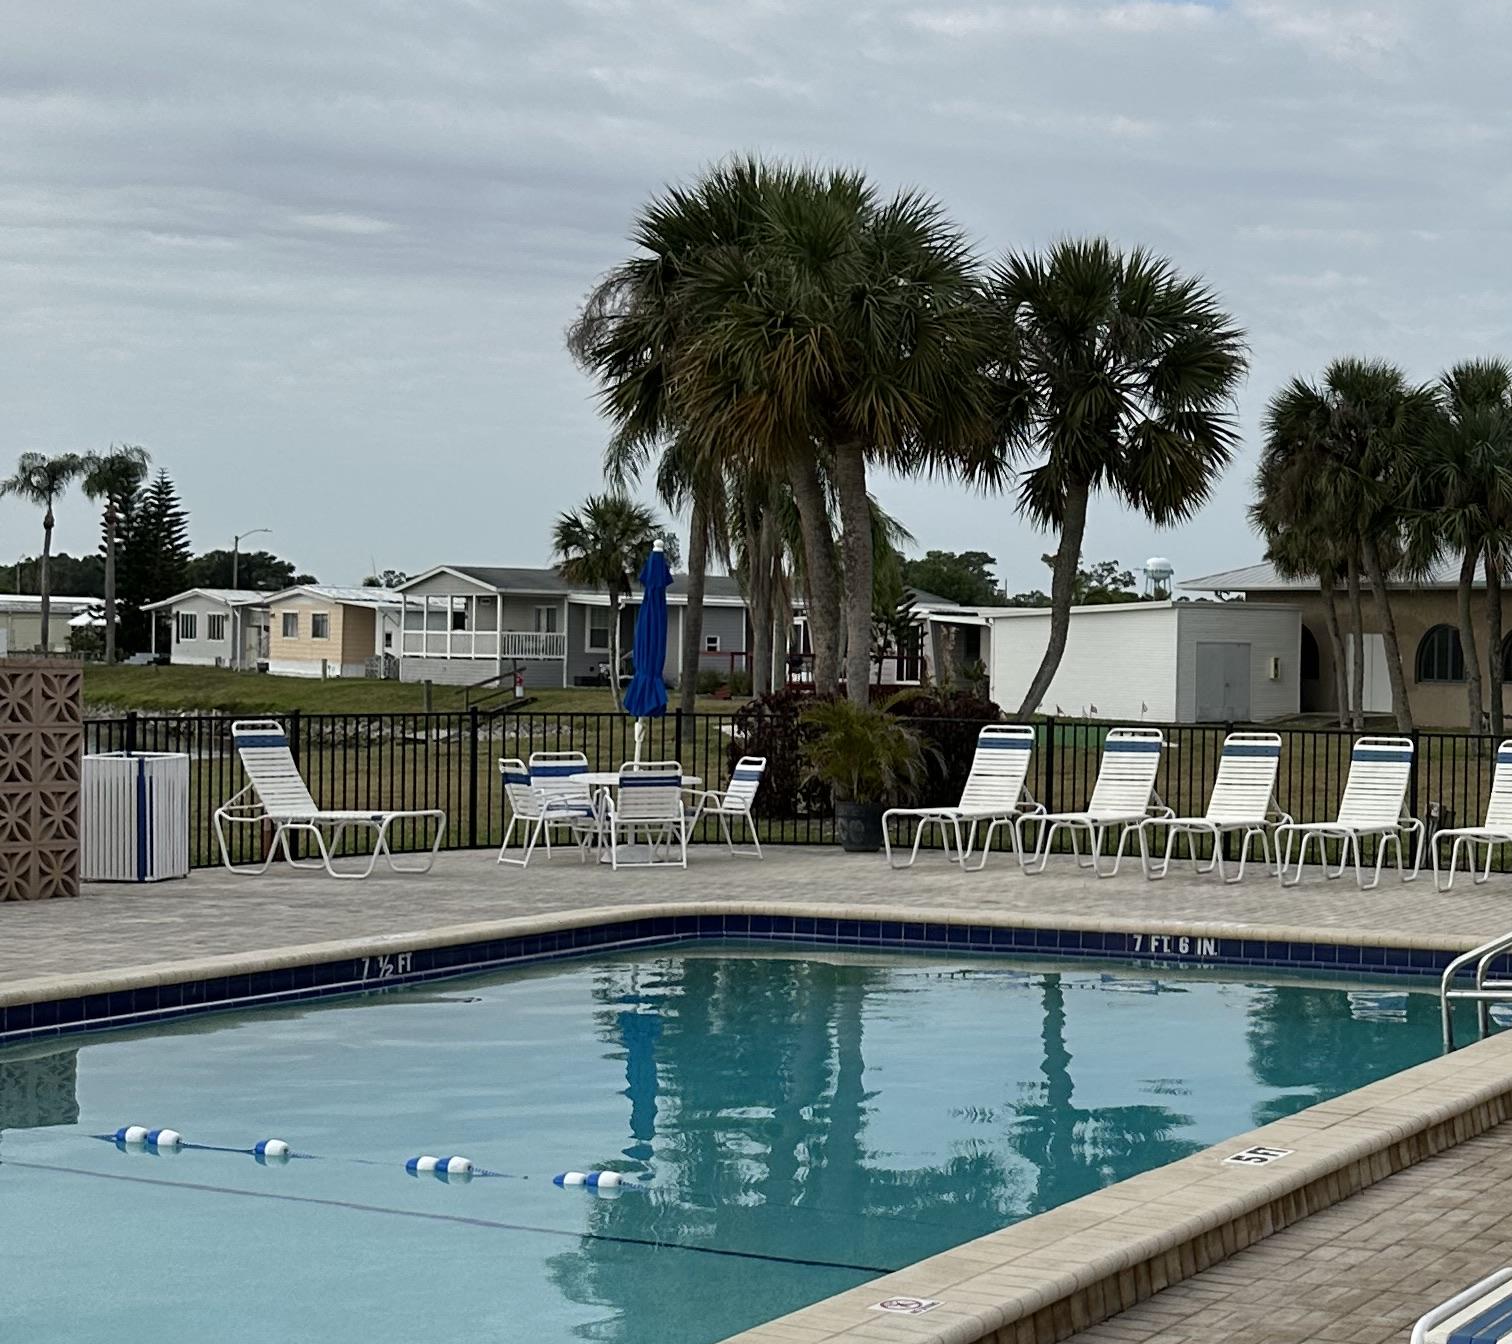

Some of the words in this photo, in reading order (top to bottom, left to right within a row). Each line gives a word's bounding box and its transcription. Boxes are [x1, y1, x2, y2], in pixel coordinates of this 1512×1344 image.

[1133, 935, 1143, 952] 7
[1179, 936, 1190, 954] 6
[398, 952, 413, 973] FT
[1246, 1147, 1288, 1157] FT
[1230, 1155, 1268, 1164] 5
